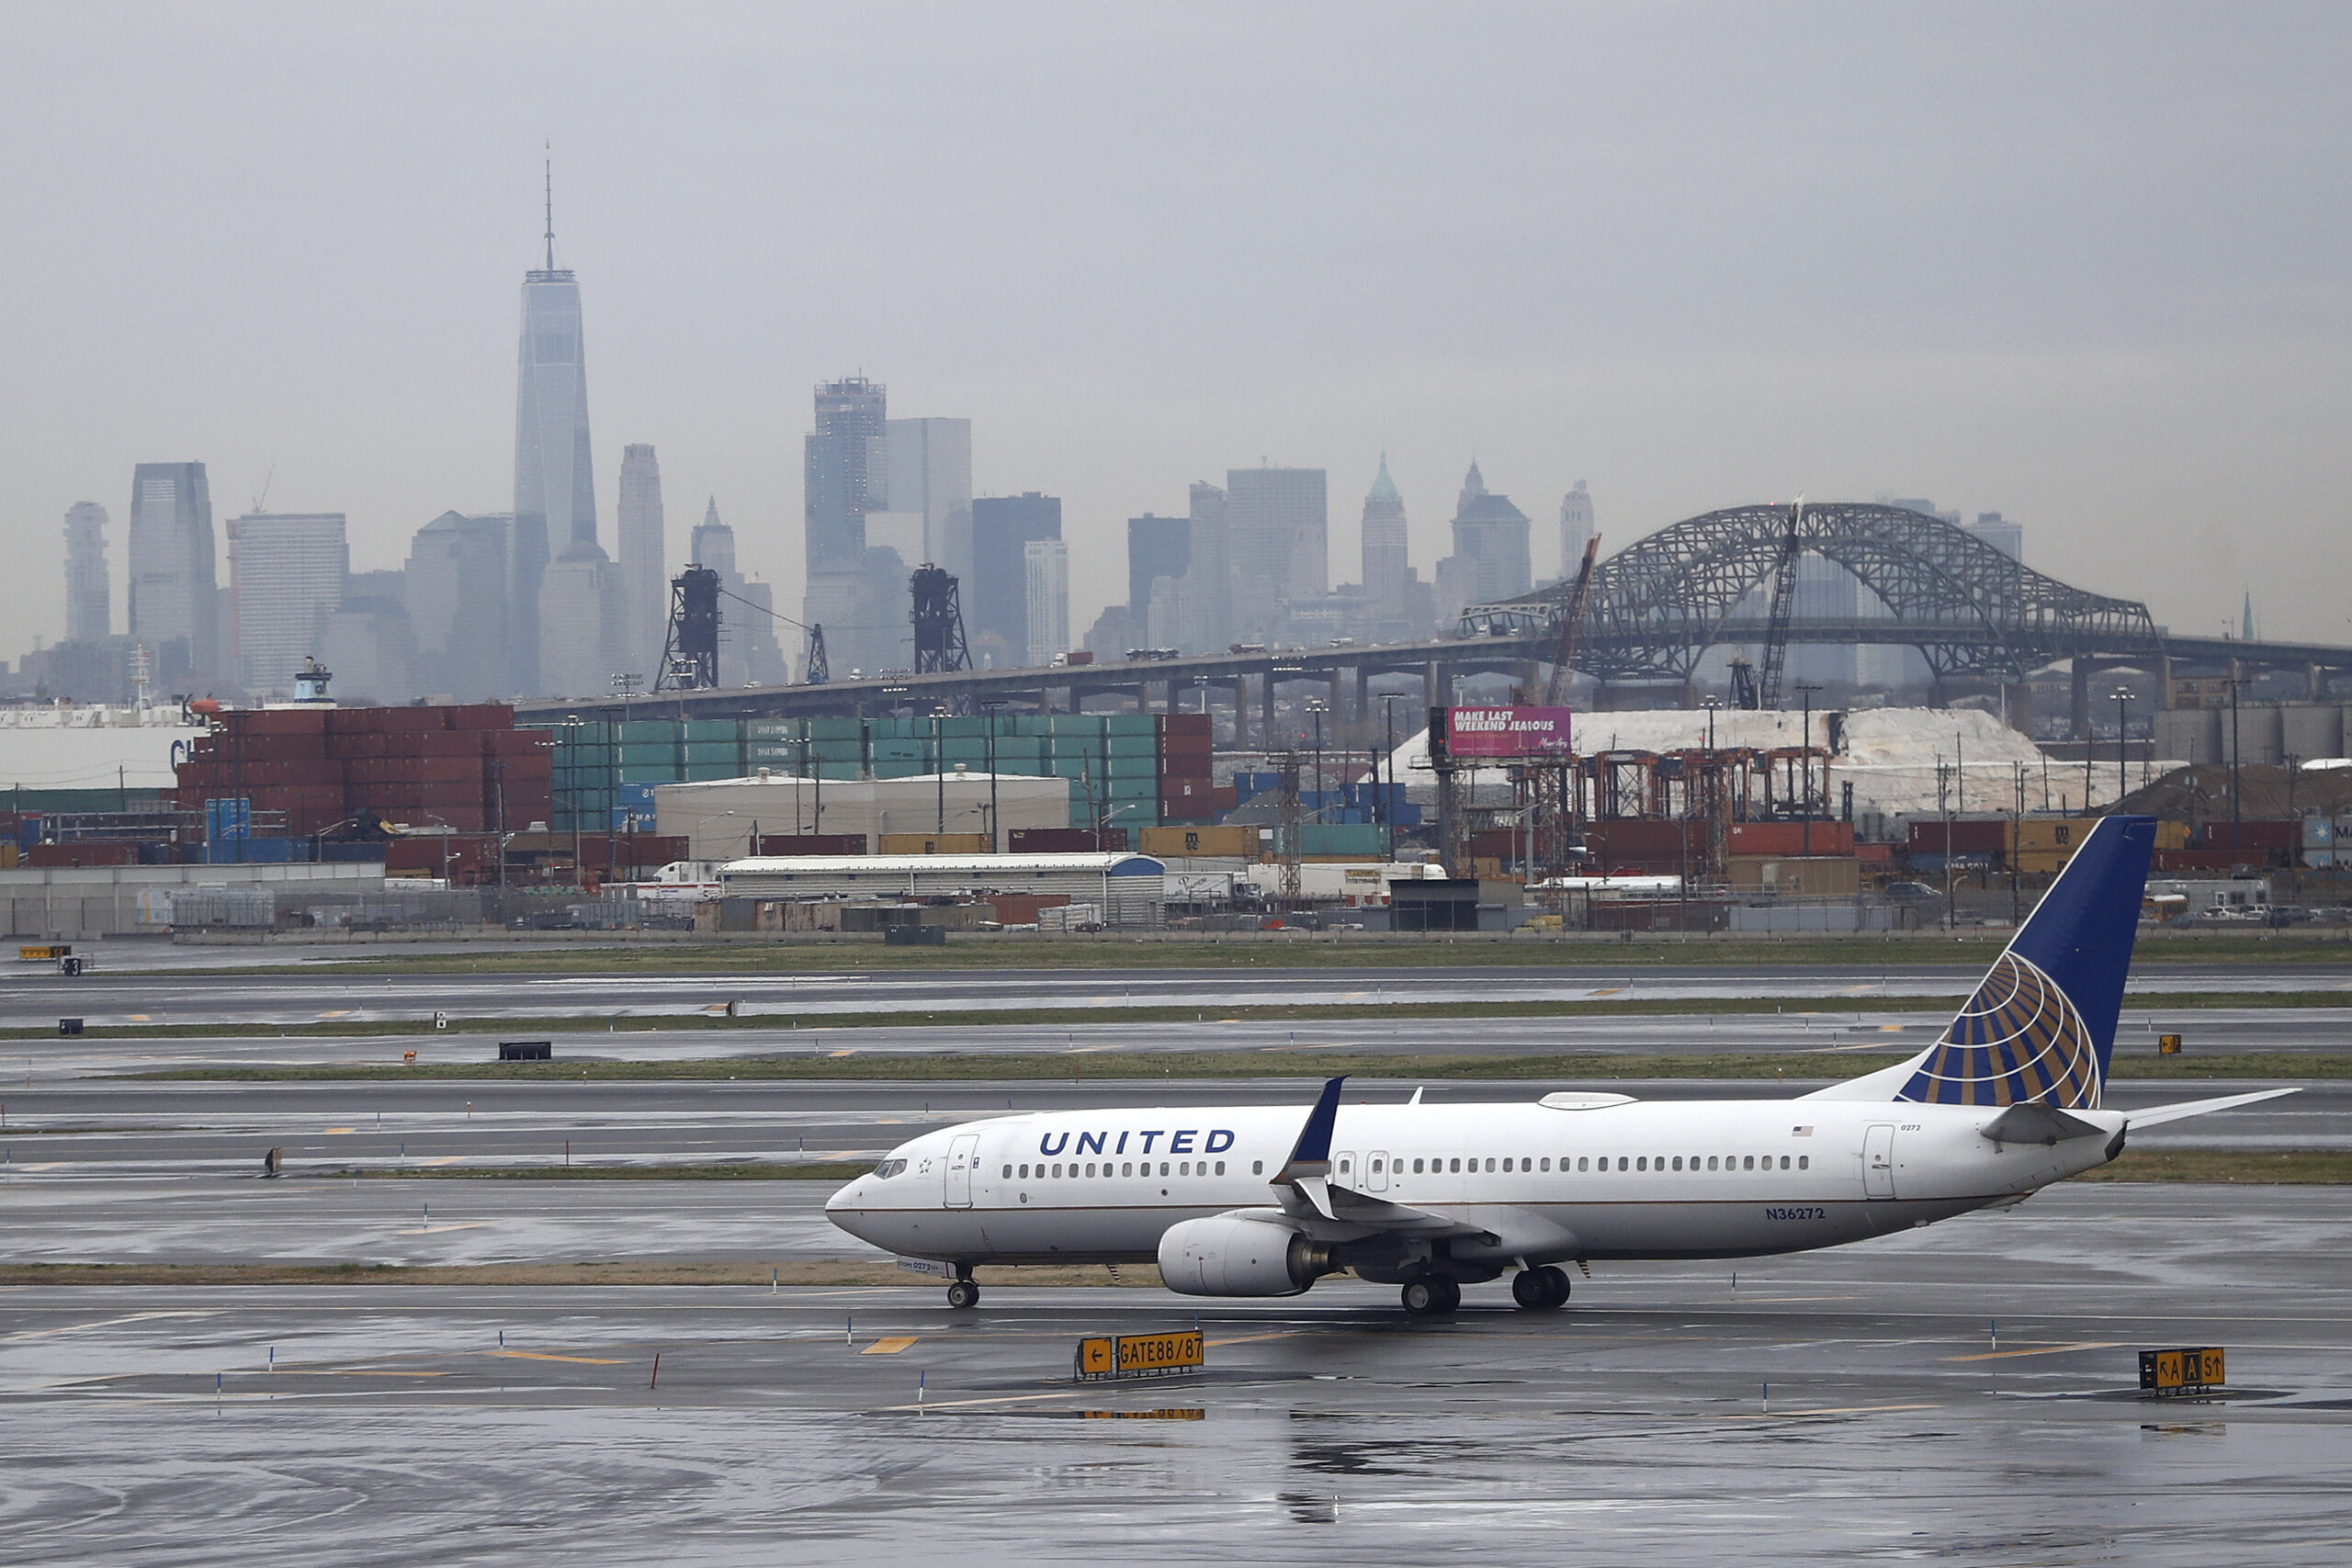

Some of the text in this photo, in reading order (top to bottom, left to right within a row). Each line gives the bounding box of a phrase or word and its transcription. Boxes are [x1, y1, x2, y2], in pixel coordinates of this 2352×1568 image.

[1454, 711, 1513, 721] MAKE LAST
[1454, 721, 1506, 731] WEEKEND
[72, 959, 80, 976] 3
[1039, 1130, 1236, 1156] UNITED
[1765, 1208, 1826, 1220] N36272
[913, 1261, 932, 1271] 0272
[2170, 1356, 2212, 1380] A A S
